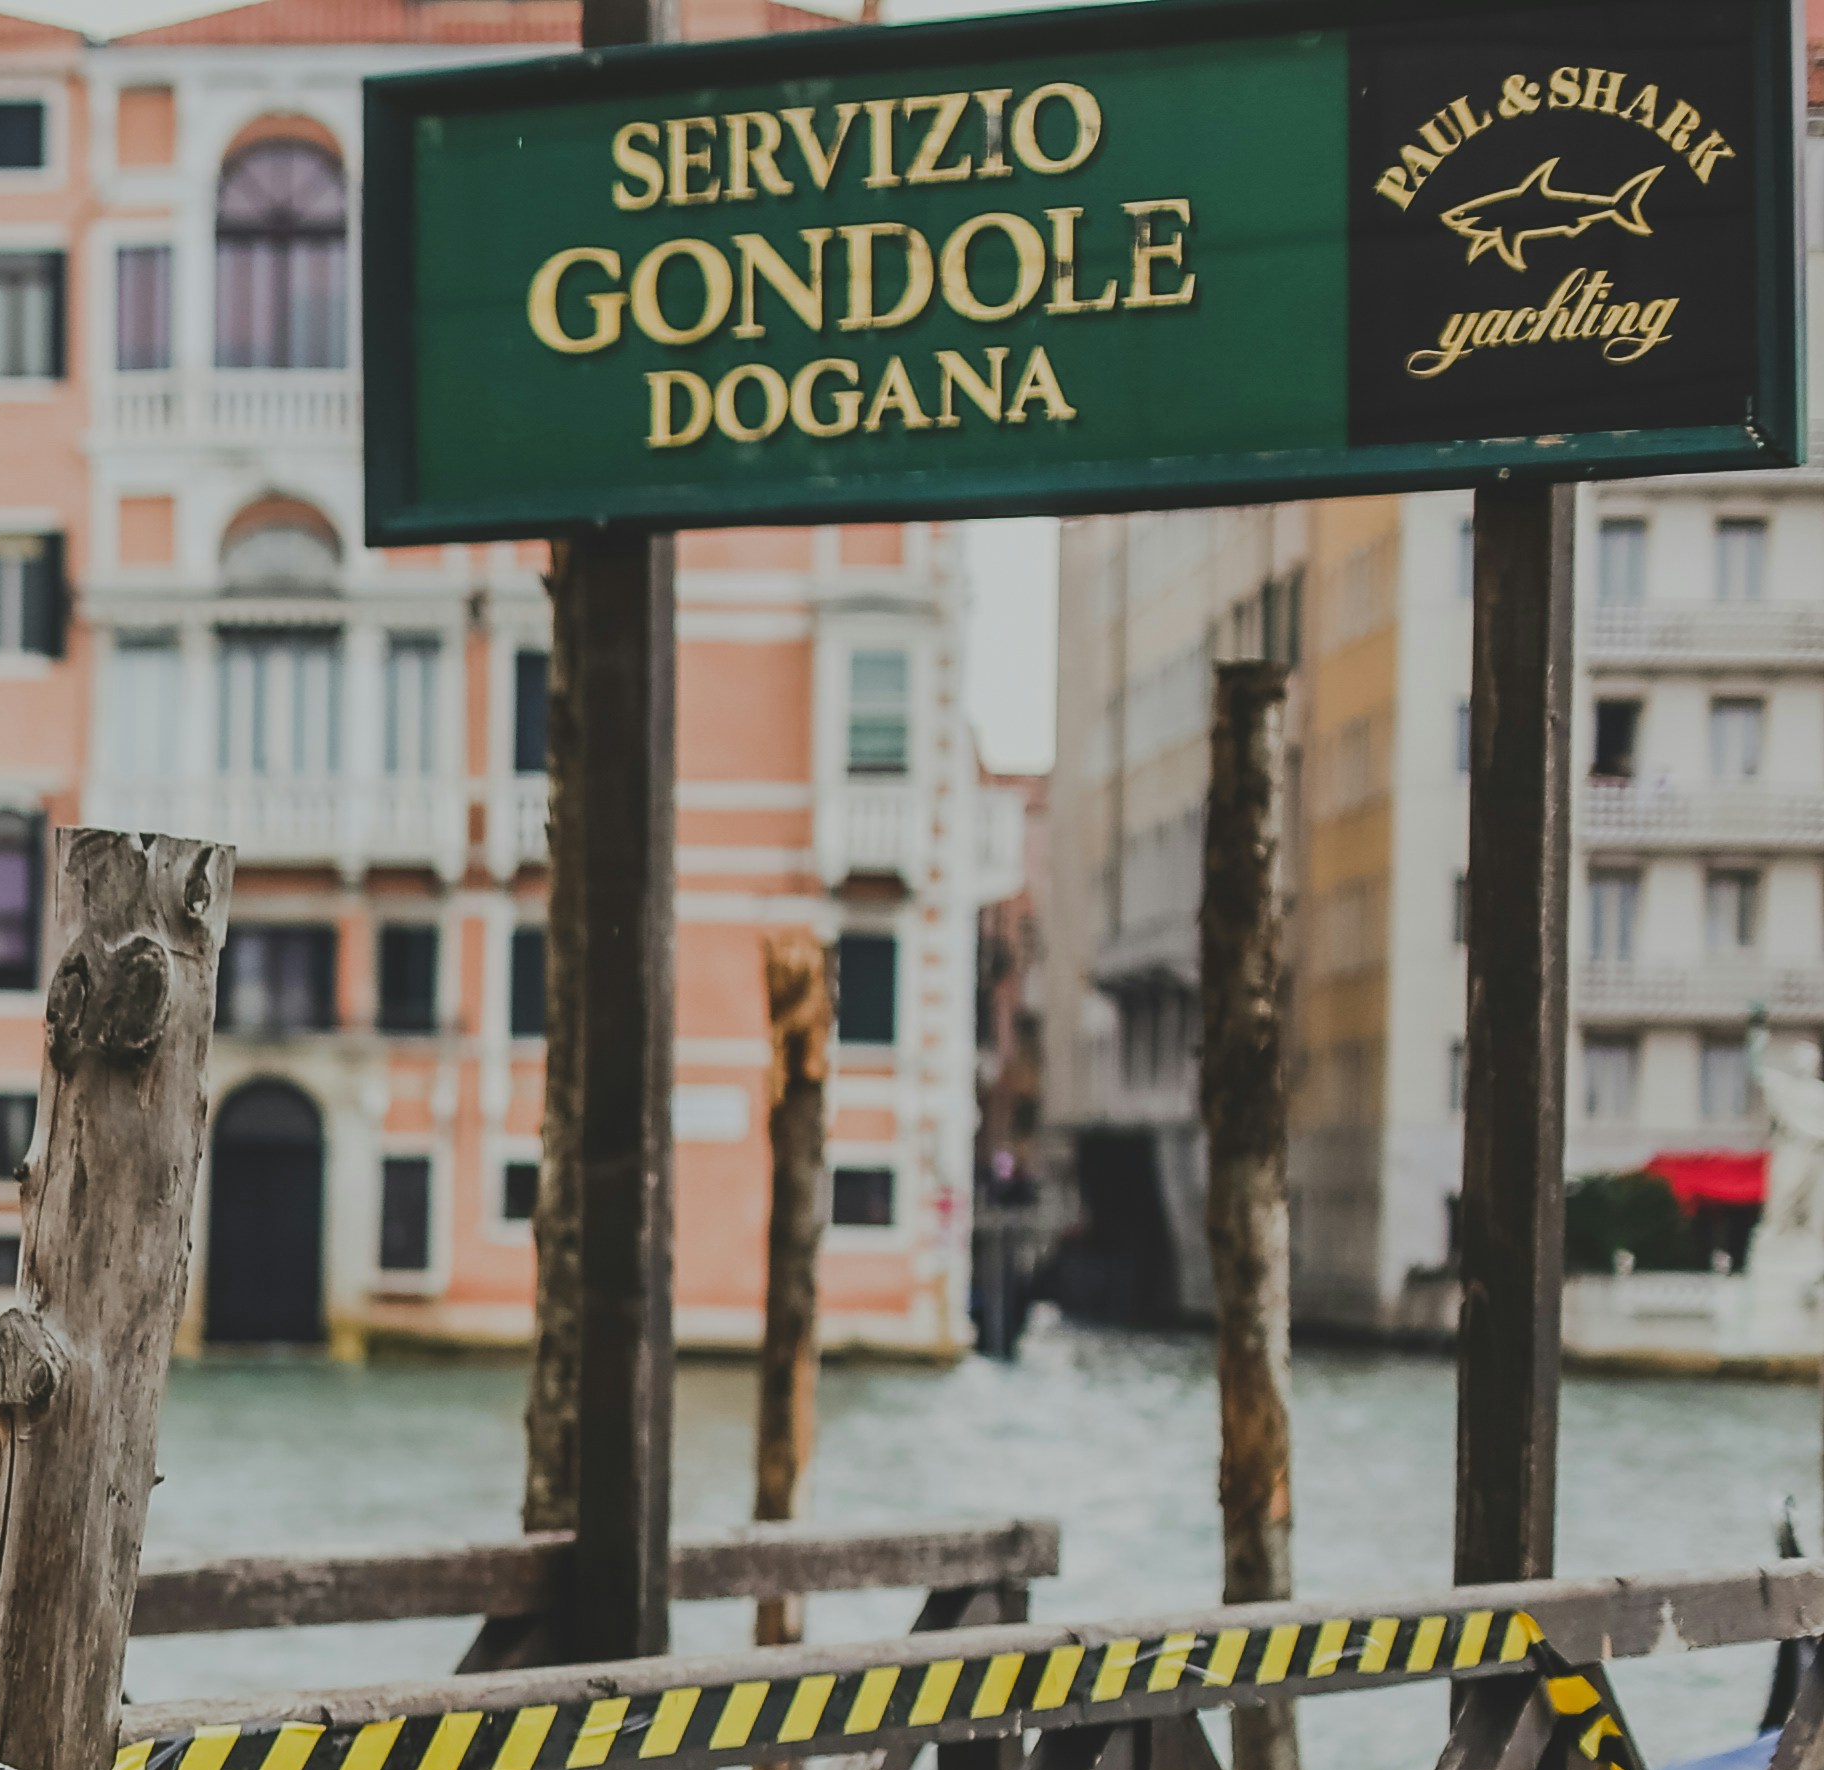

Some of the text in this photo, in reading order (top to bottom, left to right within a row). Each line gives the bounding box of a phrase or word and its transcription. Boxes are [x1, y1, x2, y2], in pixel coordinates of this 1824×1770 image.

[612, 83, 1103, 212] SERVIZIO
[1373, 66, 1736, 213] PAUL & SHARK
[527, 198, 1197, 354] GONDOLE
[1404, 266, 1681, 380] yachting
[643, 345, 1078, 449] DOGANA
